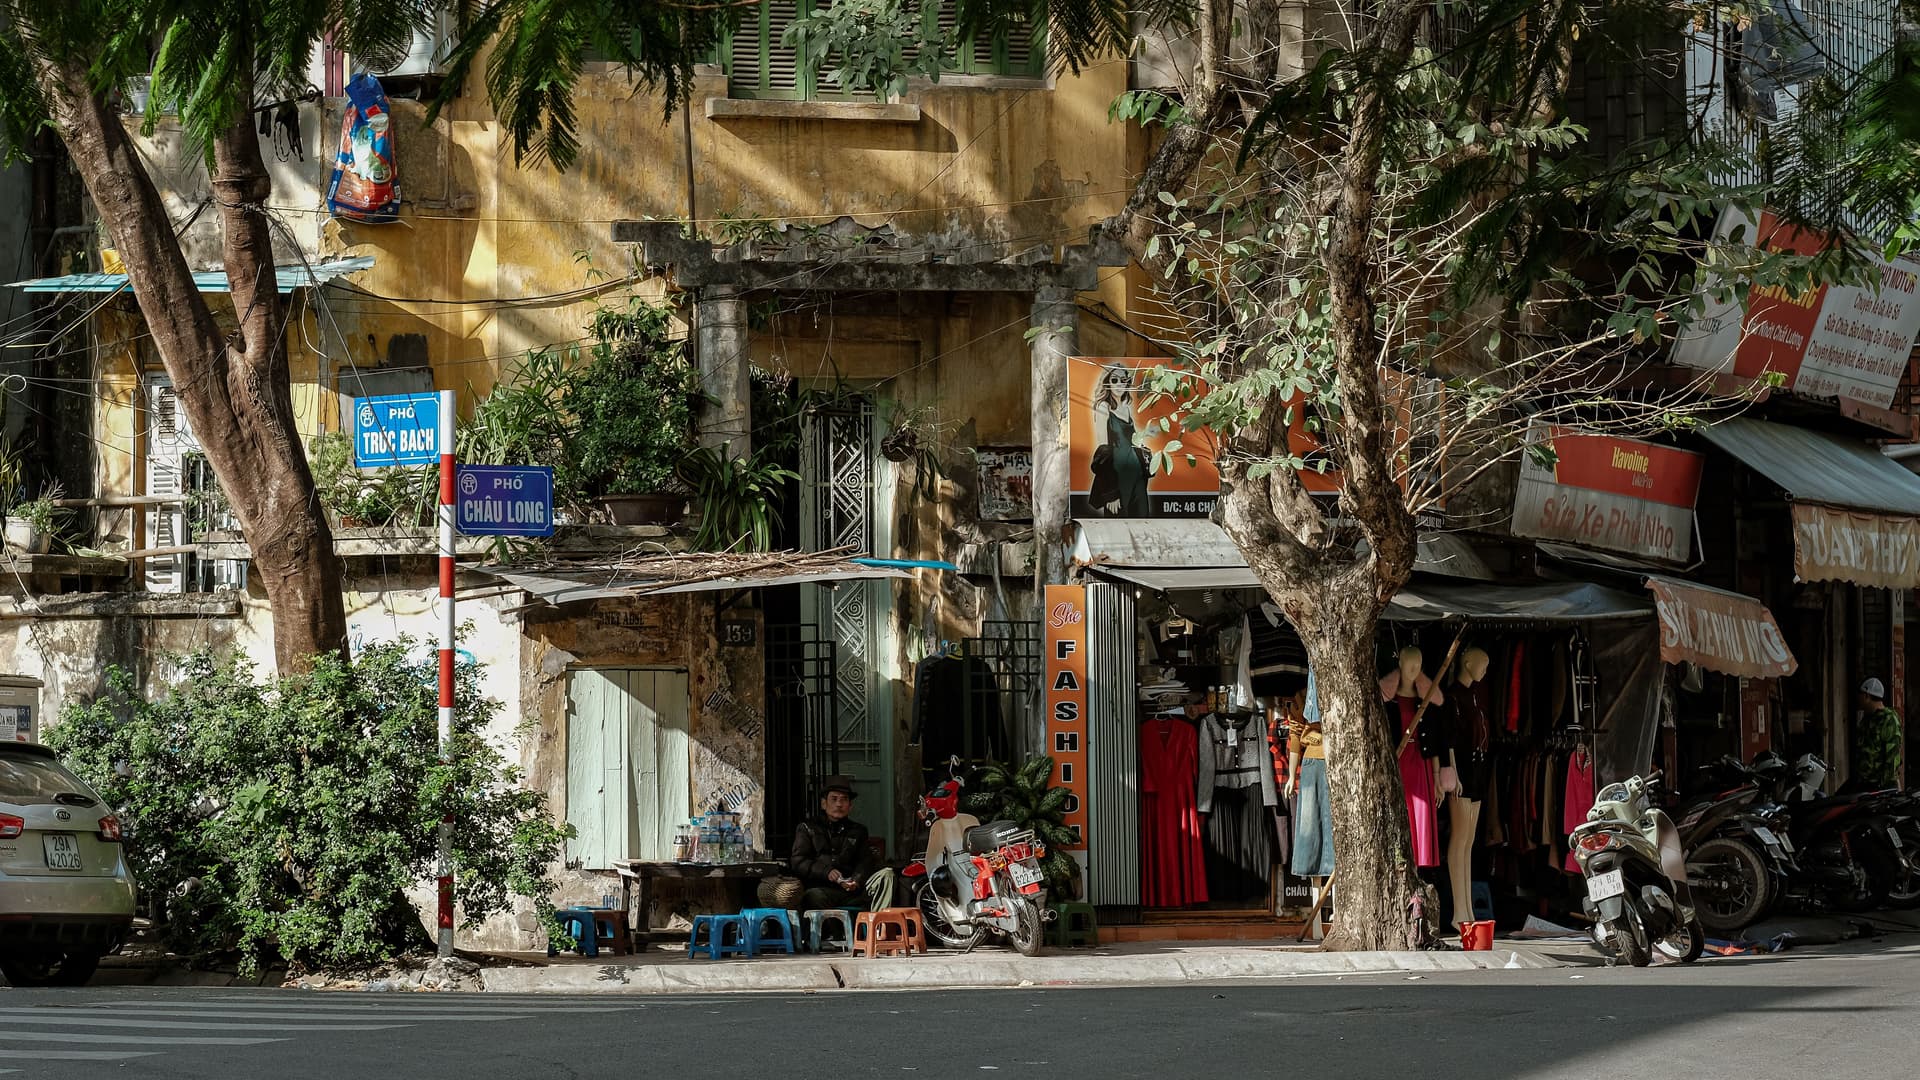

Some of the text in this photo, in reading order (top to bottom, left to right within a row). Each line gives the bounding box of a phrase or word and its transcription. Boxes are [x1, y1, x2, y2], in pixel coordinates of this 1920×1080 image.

[389, 402, 416, 420] PHỐ
[363, 427, 434, 457] TRÚC BẠCH
[1612, 446, 1649, 473] Havoline
[493, 473, 524, 490] PHỐ
[464, 495, 545, 524] CHÂU LONG
[1184, 501, 1196, 513] 48
[1198, 499, 1217, 513] CHÂ
[1540, 494, 1577, 530] Sửa
[1577, 503, 1604, 538] Xe
[1048, 602, 1082, 629] She
[58, 811, 71, 819] KIA
[996, 827, 1019, 838] HONDA
[52, 836, 71, 851] 29A
[1285, 884, 1308, 897] CHÂU
